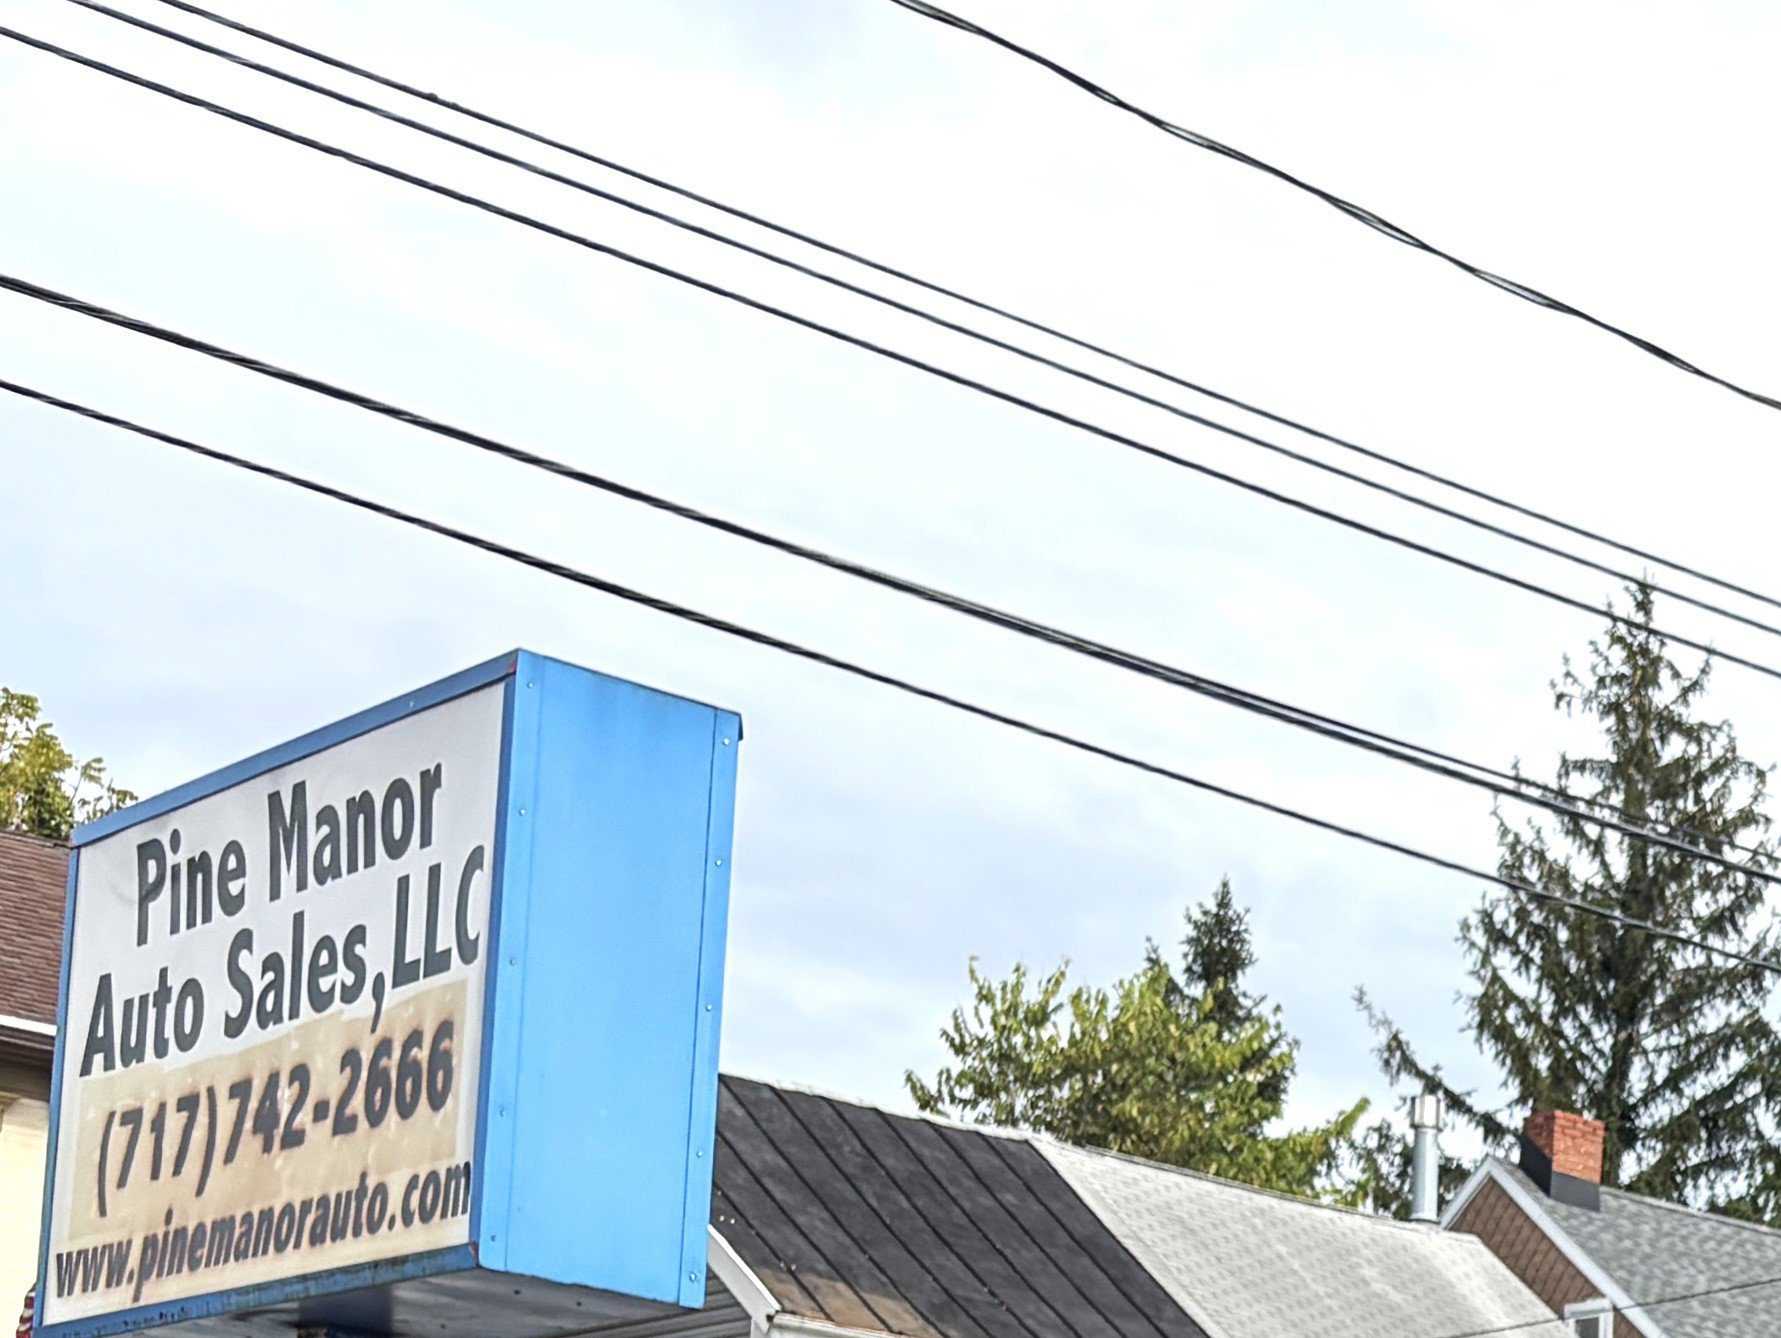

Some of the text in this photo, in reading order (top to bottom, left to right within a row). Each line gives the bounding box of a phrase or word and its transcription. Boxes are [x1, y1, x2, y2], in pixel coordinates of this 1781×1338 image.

[135, 761, 443, 947] Pine Manor
[79, 965, 205, 1078] Auto
[97, 1018, 455, 1218] (717)742-2666
[55, 1159, 472, 1303] www.pinemanorauto.com
